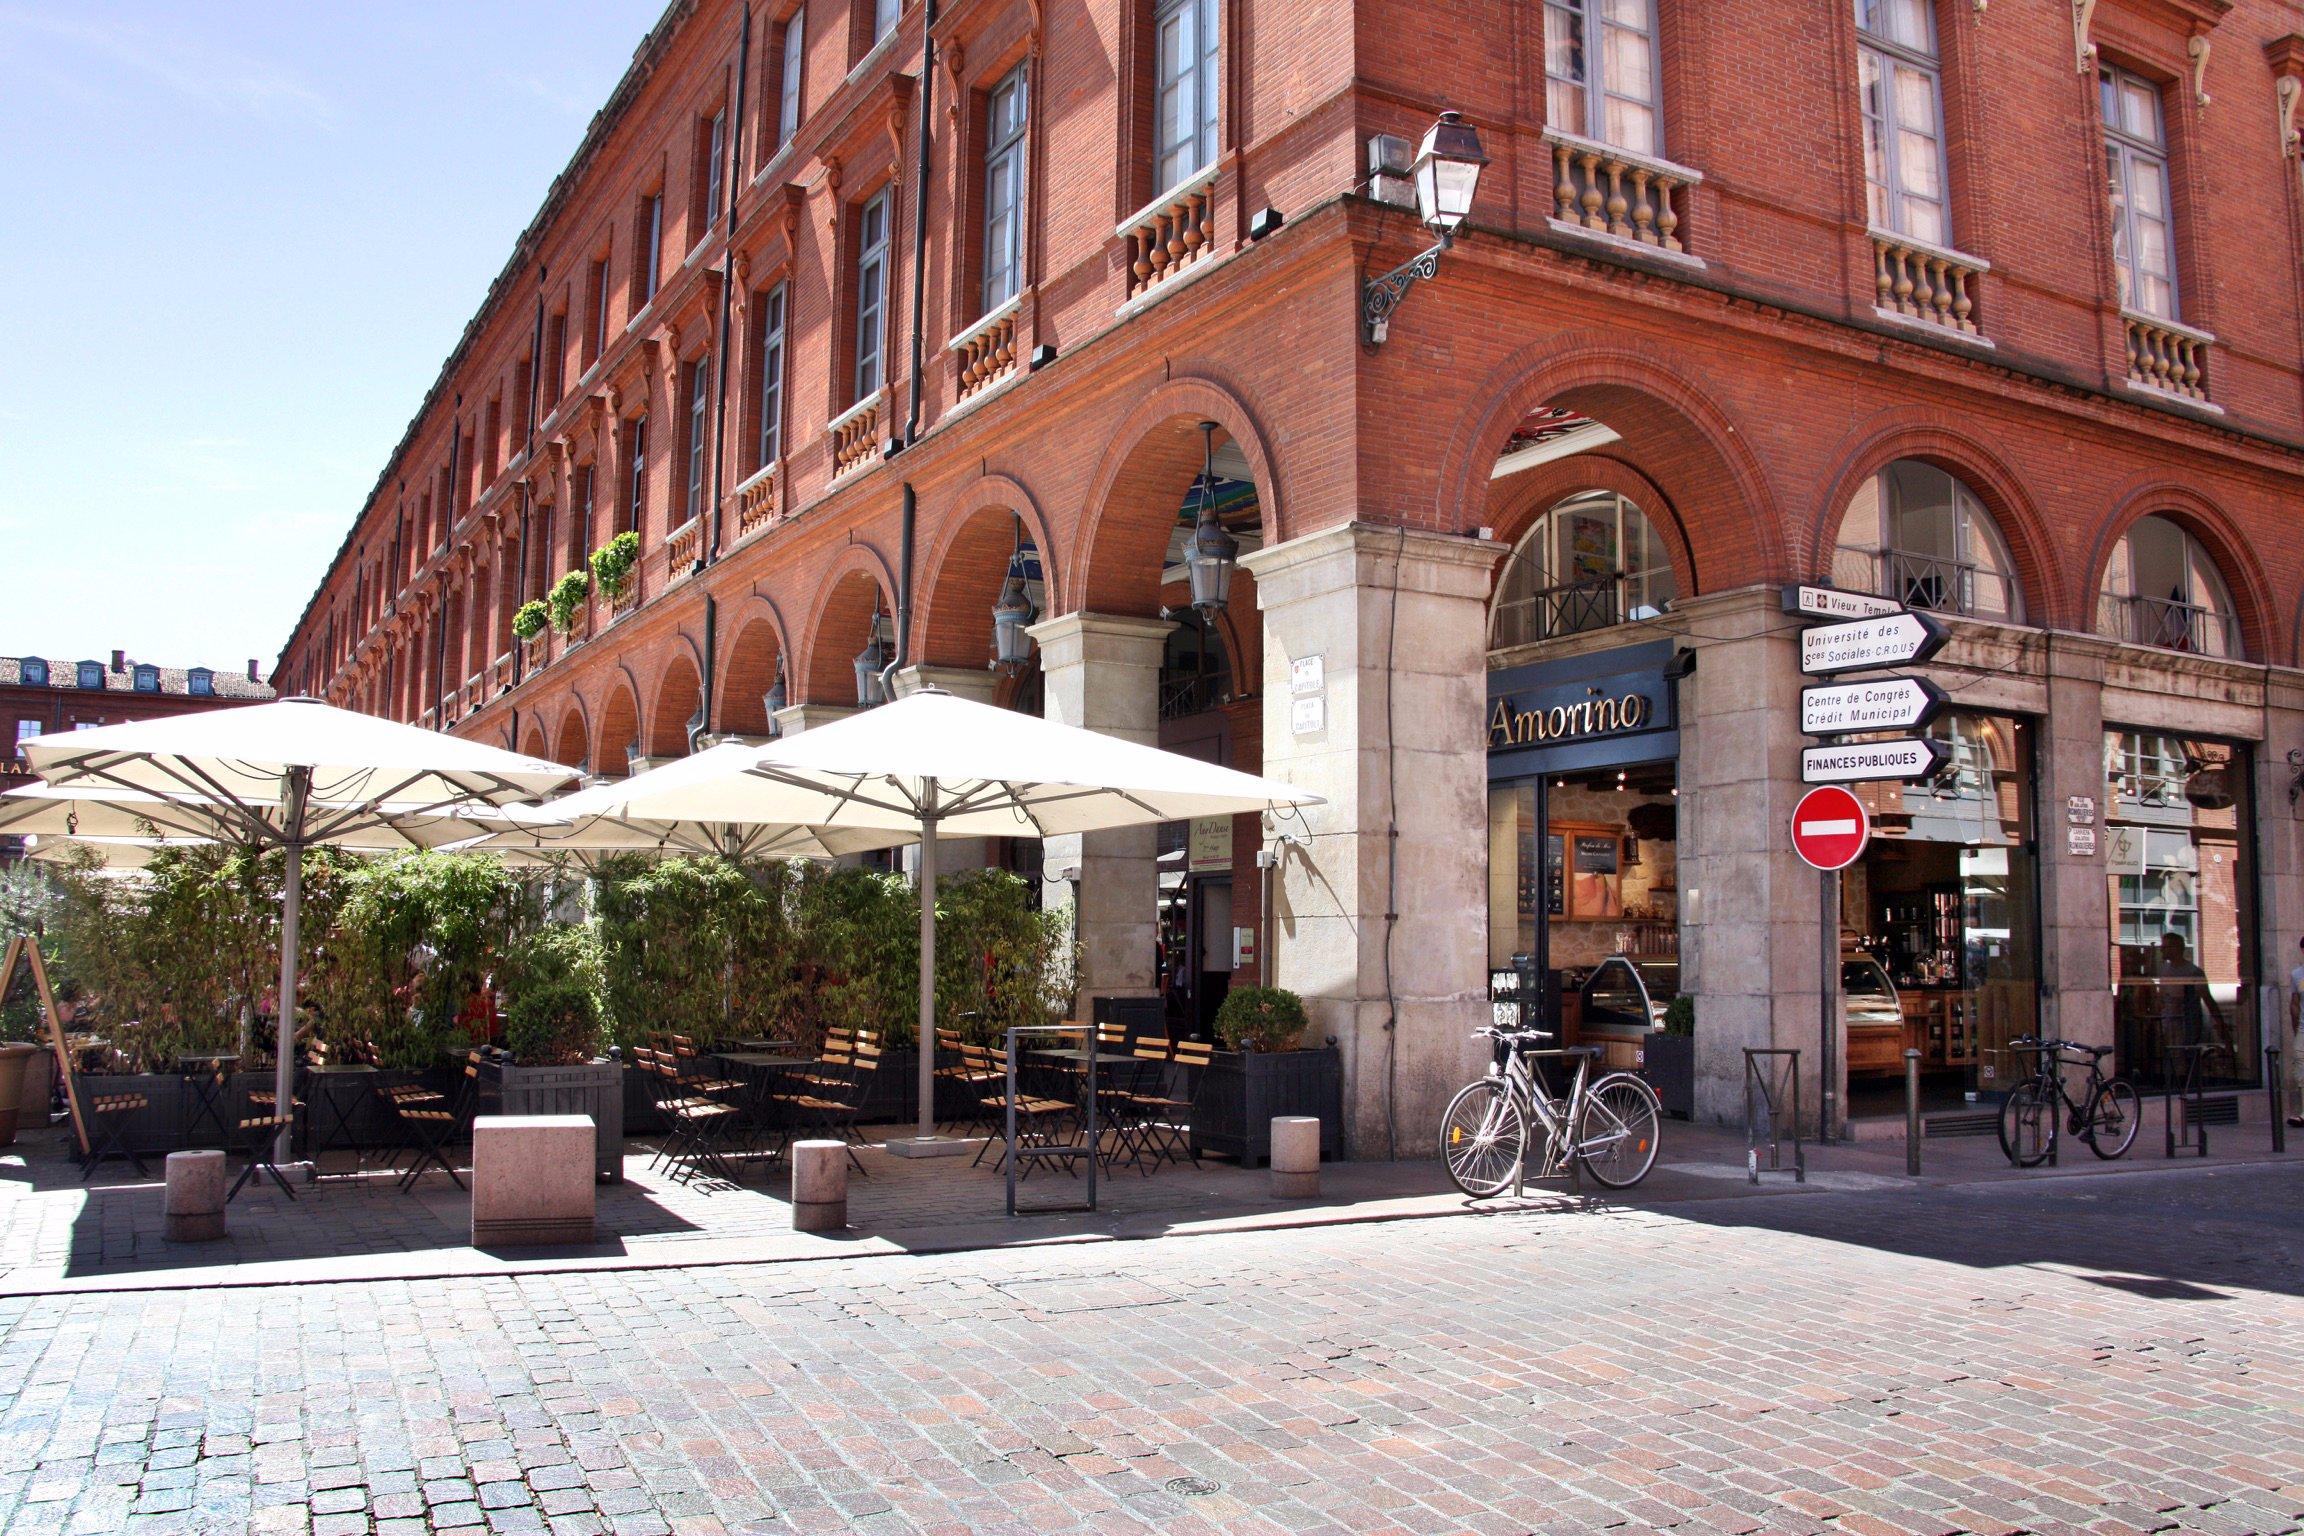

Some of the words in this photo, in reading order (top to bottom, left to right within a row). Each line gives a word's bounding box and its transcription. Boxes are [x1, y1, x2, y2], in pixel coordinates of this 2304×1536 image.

[1832, 597, 1857, 612] Vieux
[1807, 628, 1869, 647] Université
[1878, 626, 1899, 637] des
[1828, 648, 1871, 662] Sociales
[1807, 696, 1841, 707] Centre
[1847, 692, 1860, 704] de
[1865, 688, 1910, 704] Congrès
[1487, 687, 1642, 747] Amorino
[1807, 711, 1842, 725] Crédit
[1850, 705, 1911, 720] Municipal
[1807, 756, 1857, 771] FINANCES
[1858, 752, 1917, 767] PUBLIQUES
